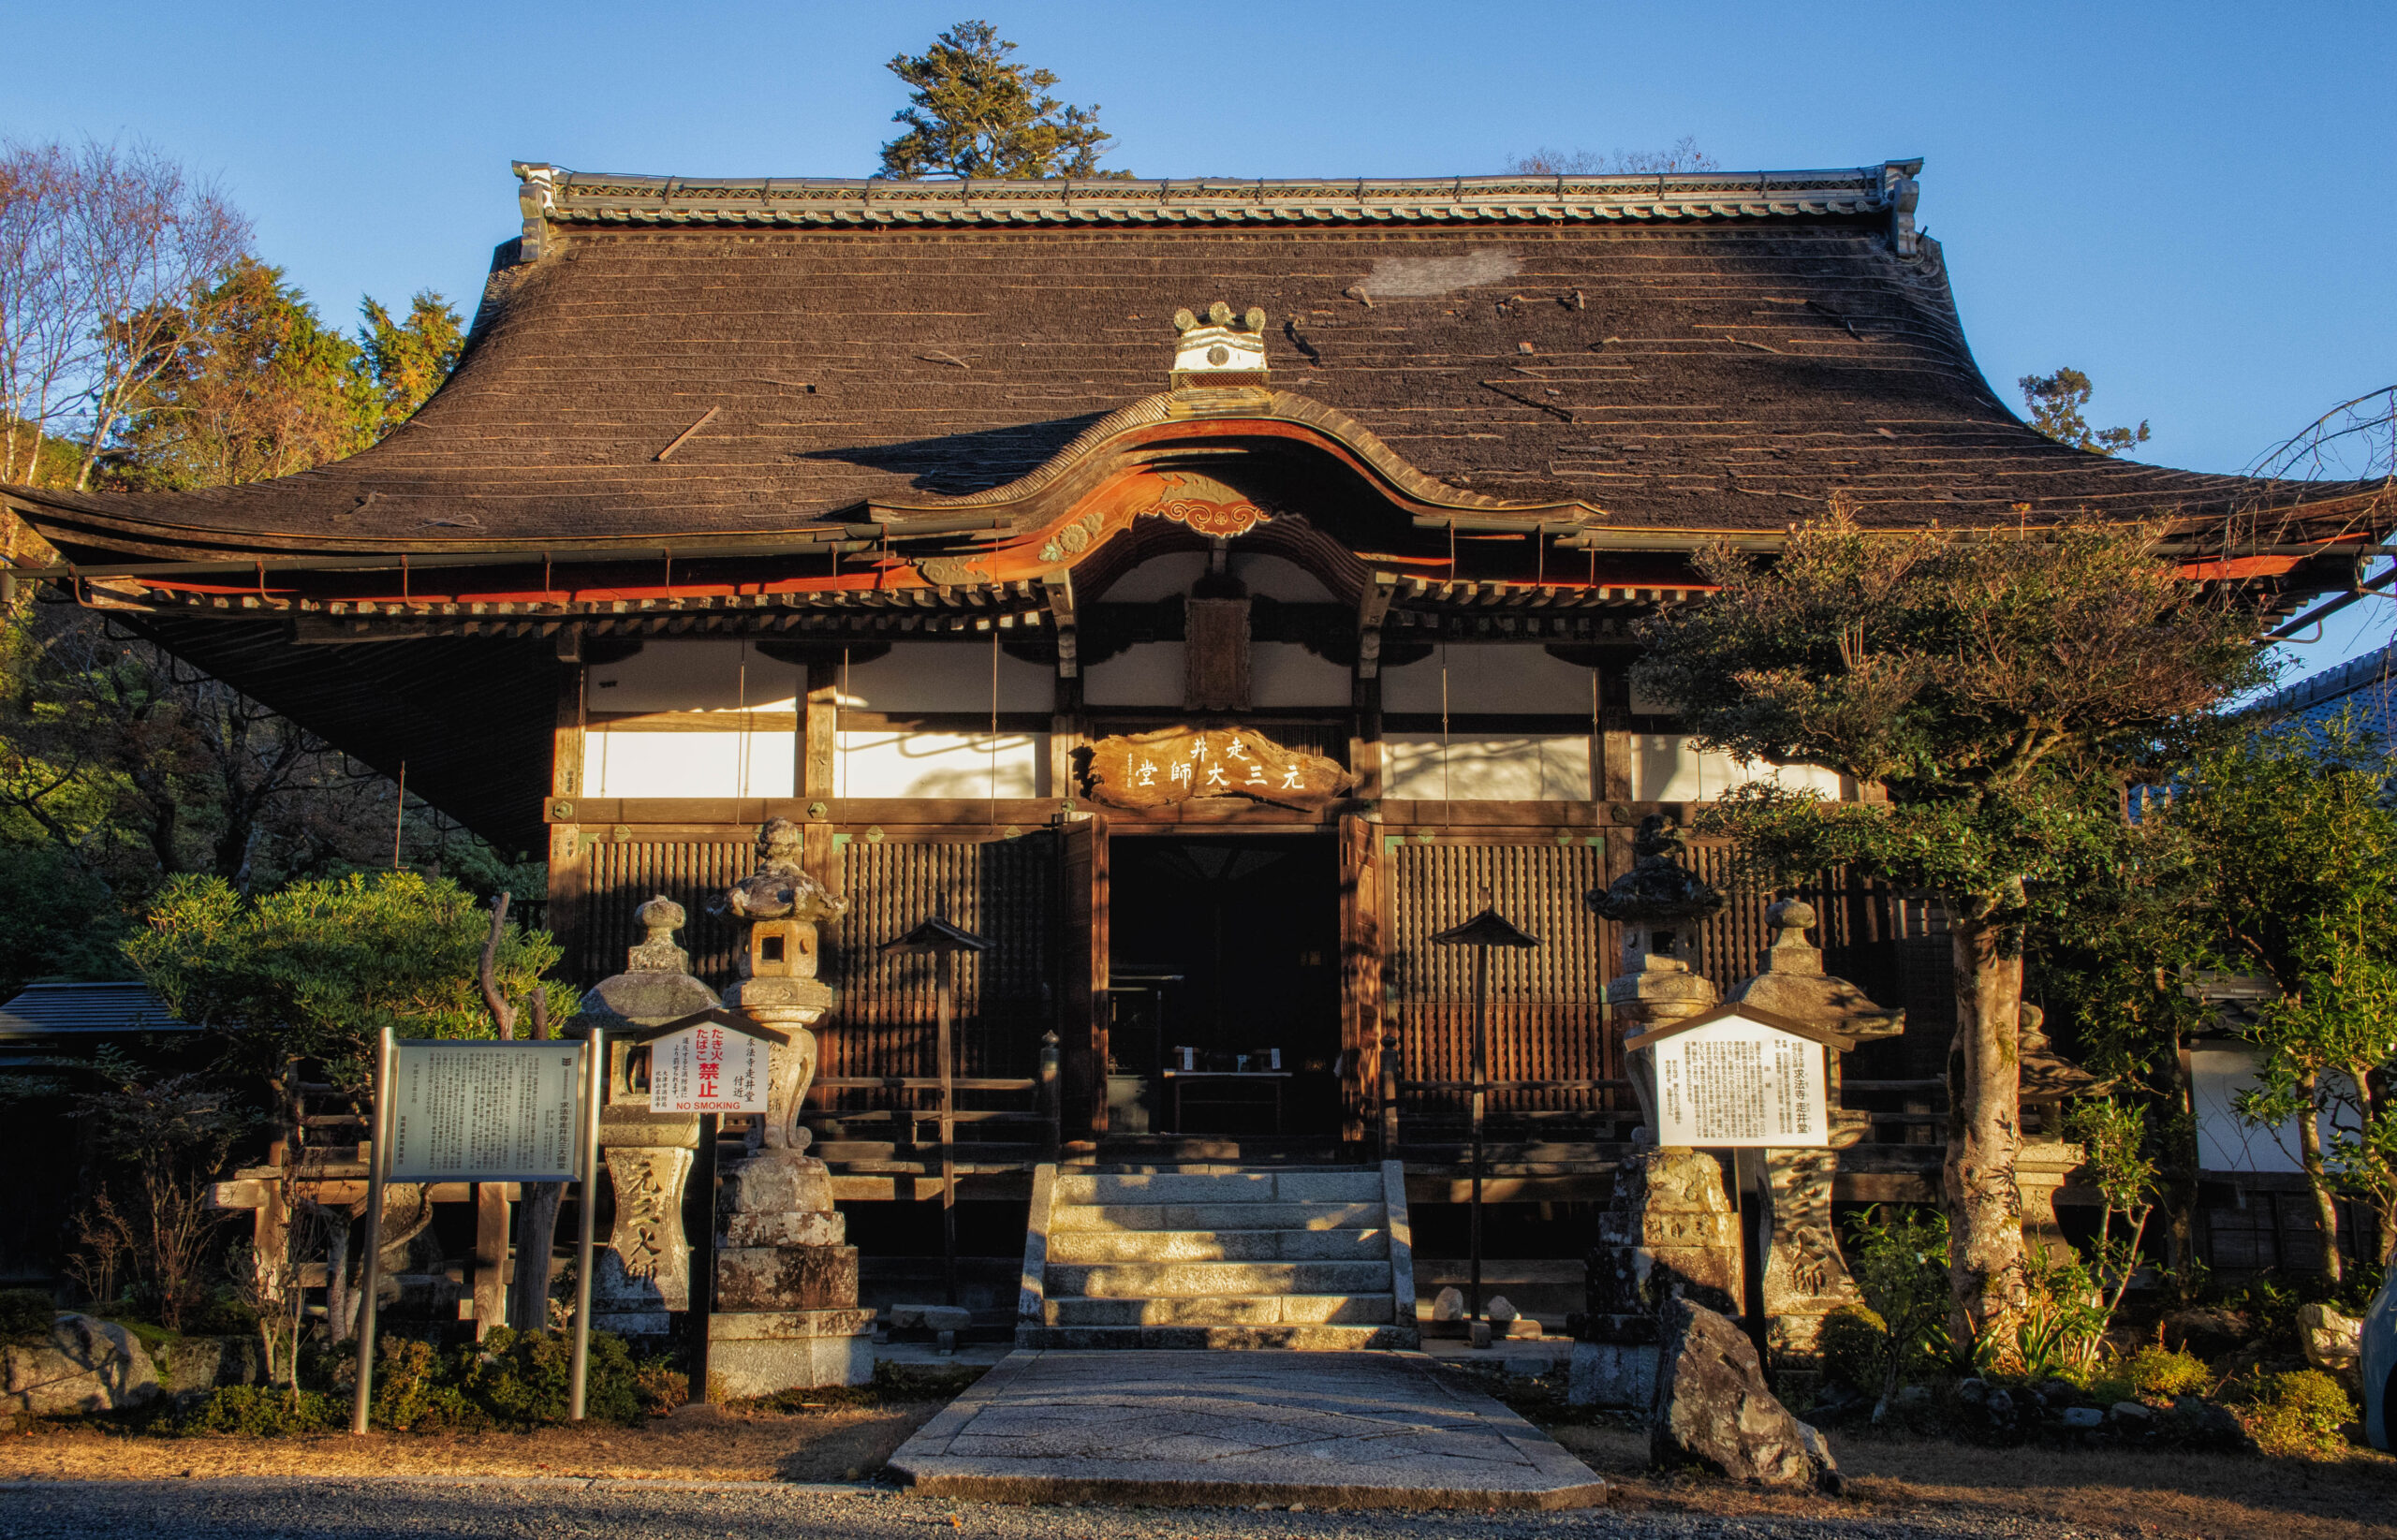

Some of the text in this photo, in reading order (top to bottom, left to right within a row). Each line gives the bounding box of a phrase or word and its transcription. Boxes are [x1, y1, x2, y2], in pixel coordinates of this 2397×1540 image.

[1135, 760, 1305, 790] 元三大師堂
[697, 1029, 708, 1061] たばこ
[712, 1029, 724, 1061] たき火
[698, 1063, 719, 1097] 禁止
[733, 1076, 744, 1097] 付近
[1793, 1069, 1807, 1134] 求法寺 走井堂
